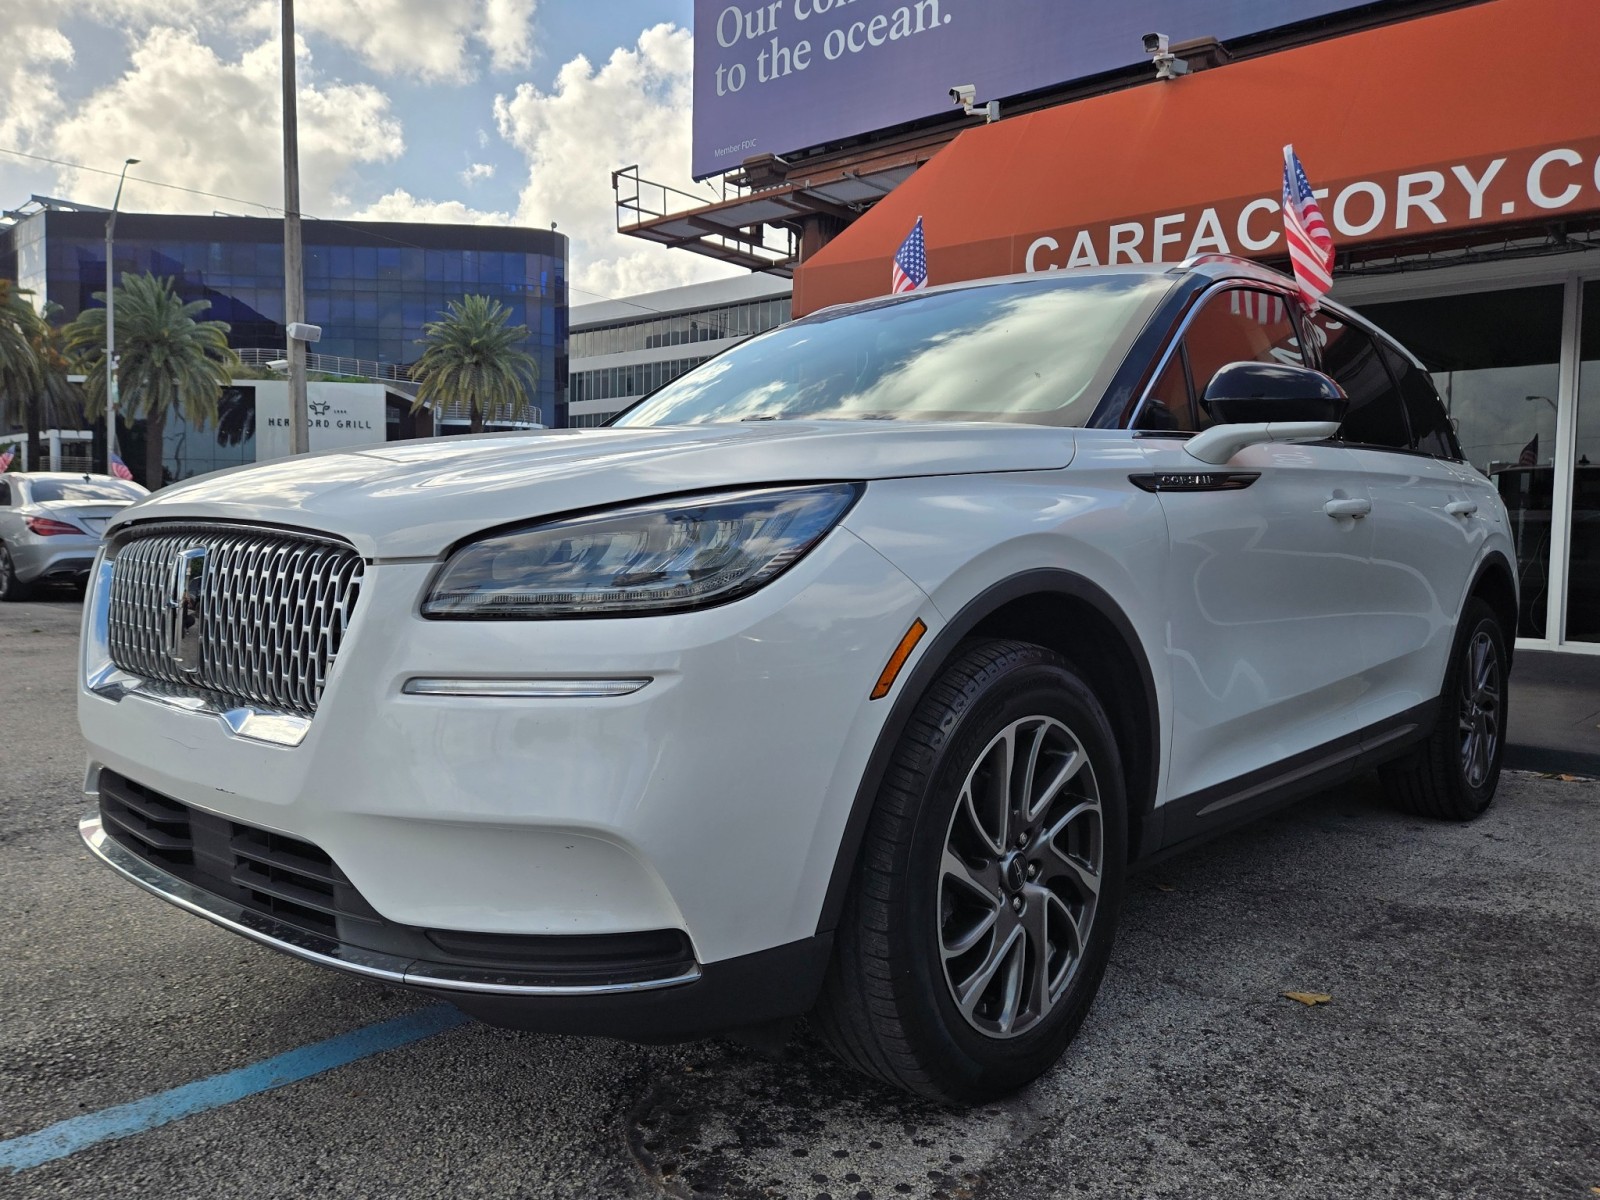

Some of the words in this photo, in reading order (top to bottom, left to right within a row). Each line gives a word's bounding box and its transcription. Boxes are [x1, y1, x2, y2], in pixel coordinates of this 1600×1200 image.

[716, 0, 782, 48] Our
[715, 63, 746, 97] to
[757, 37, 811, 83] the
[823, 0, 952, 61] ocean.
[714, 144, 741, 158] Member
[741, 138, 757, 150] FDIC
[1025, 148, 1600, 273] CARFACORY.C
[268, 418, 330, 429] HERORD
[336, 419, 372, 430] GRILL
